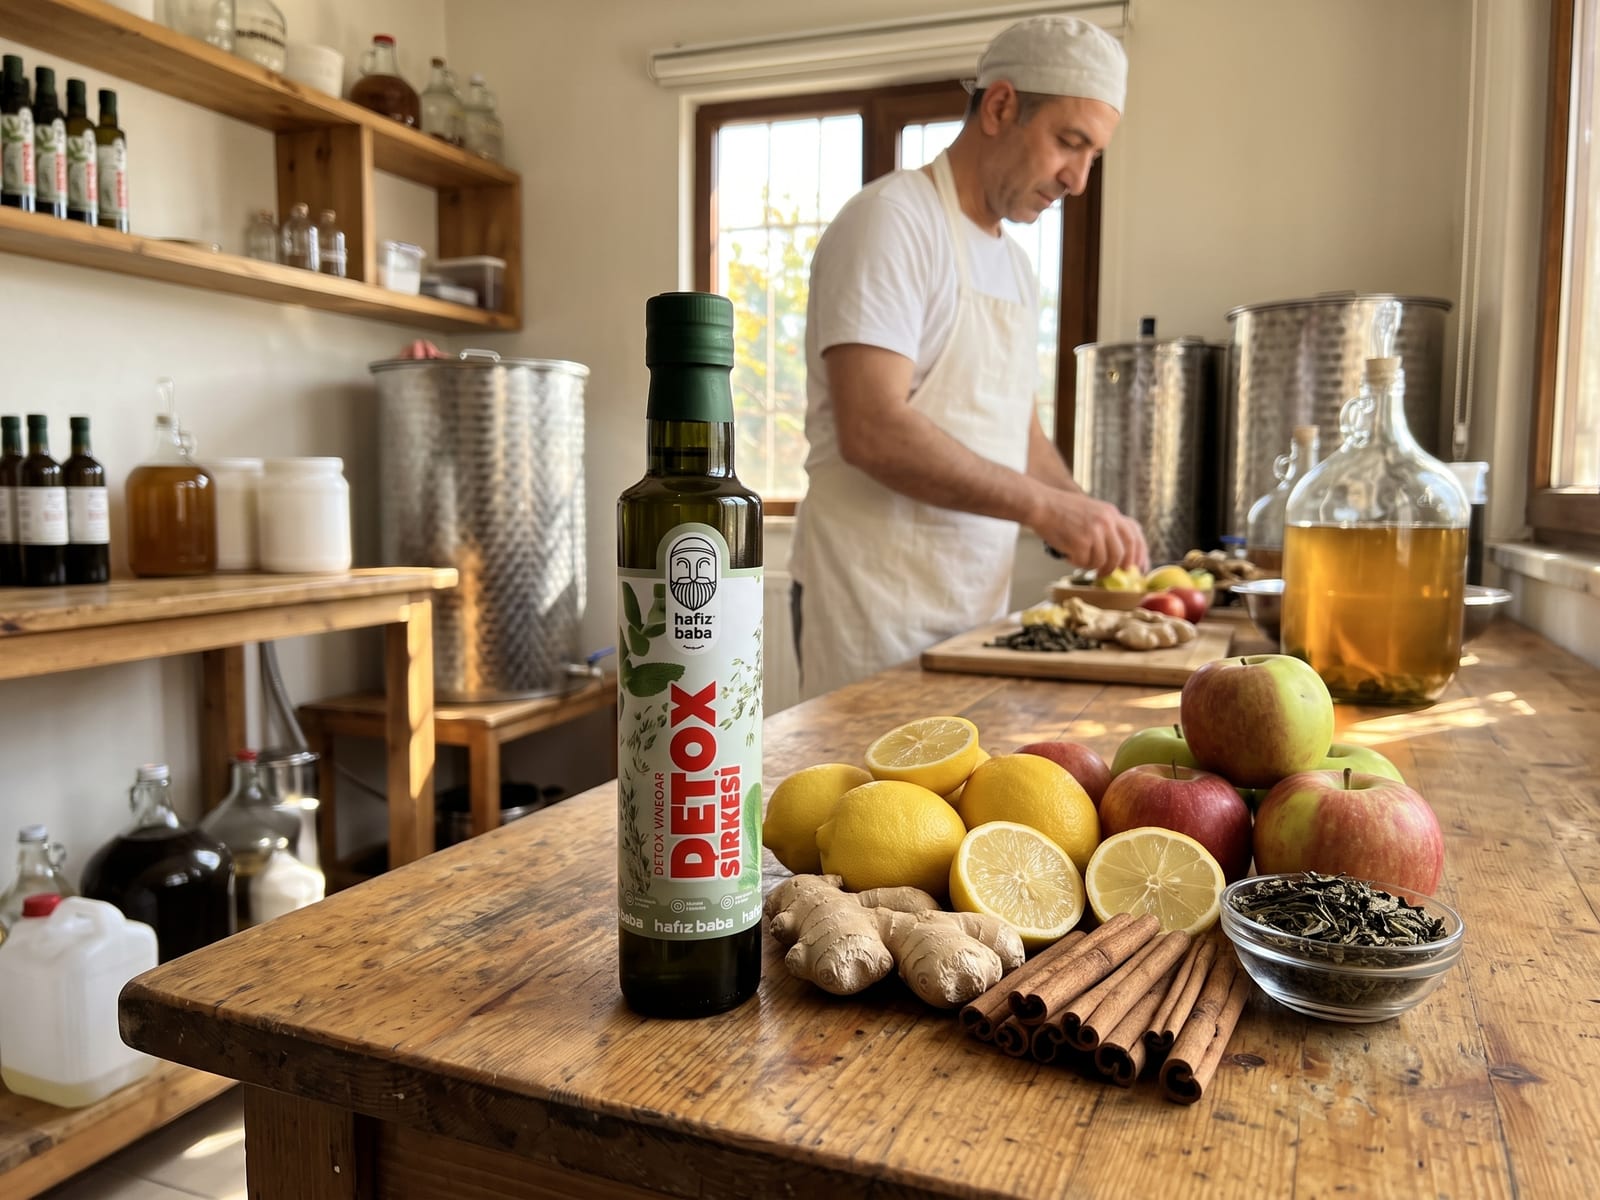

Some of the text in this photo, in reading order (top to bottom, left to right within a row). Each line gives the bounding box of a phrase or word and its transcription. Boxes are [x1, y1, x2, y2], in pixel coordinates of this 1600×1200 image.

[674, 612, 713, 625] hafiz
[674, 626, 713, 639] baba
[670, 680, 717, 879] DETOX
[653, 833, 665, 876] DETOX
[696, 917, 734, 933] baba
